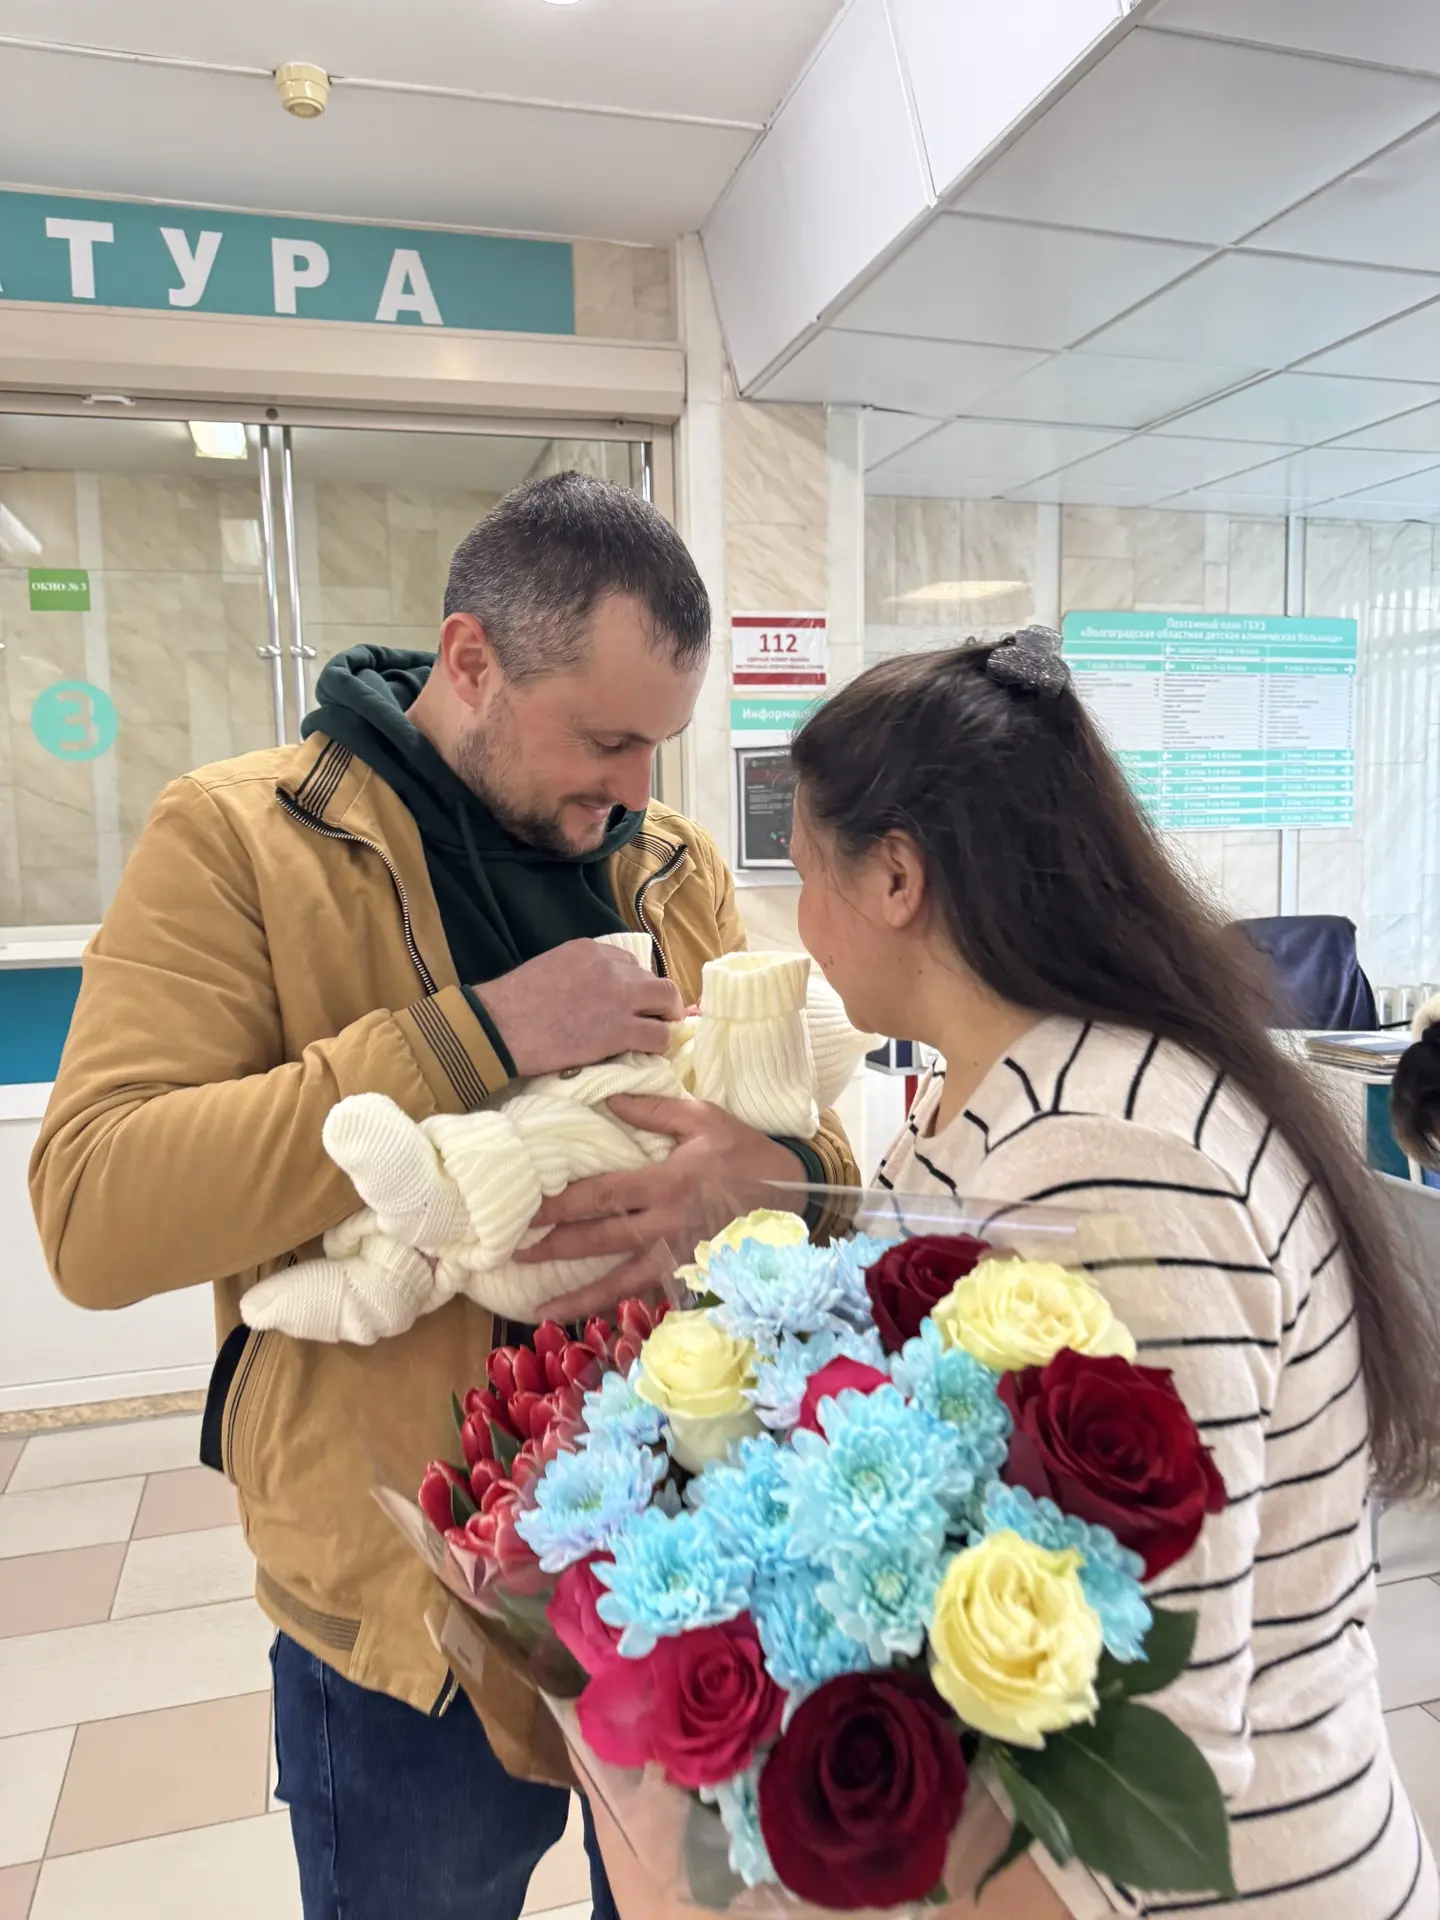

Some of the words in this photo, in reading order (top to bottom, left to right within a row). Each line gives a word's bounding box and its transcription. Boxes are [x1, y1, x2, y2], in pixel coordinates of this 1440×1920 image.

[0, 217, 443, 325] ТУРА
[759, 633, 798, 653] 112
[1220, 621, 1242, 631] план
[56, 689, 98, 751] 3
